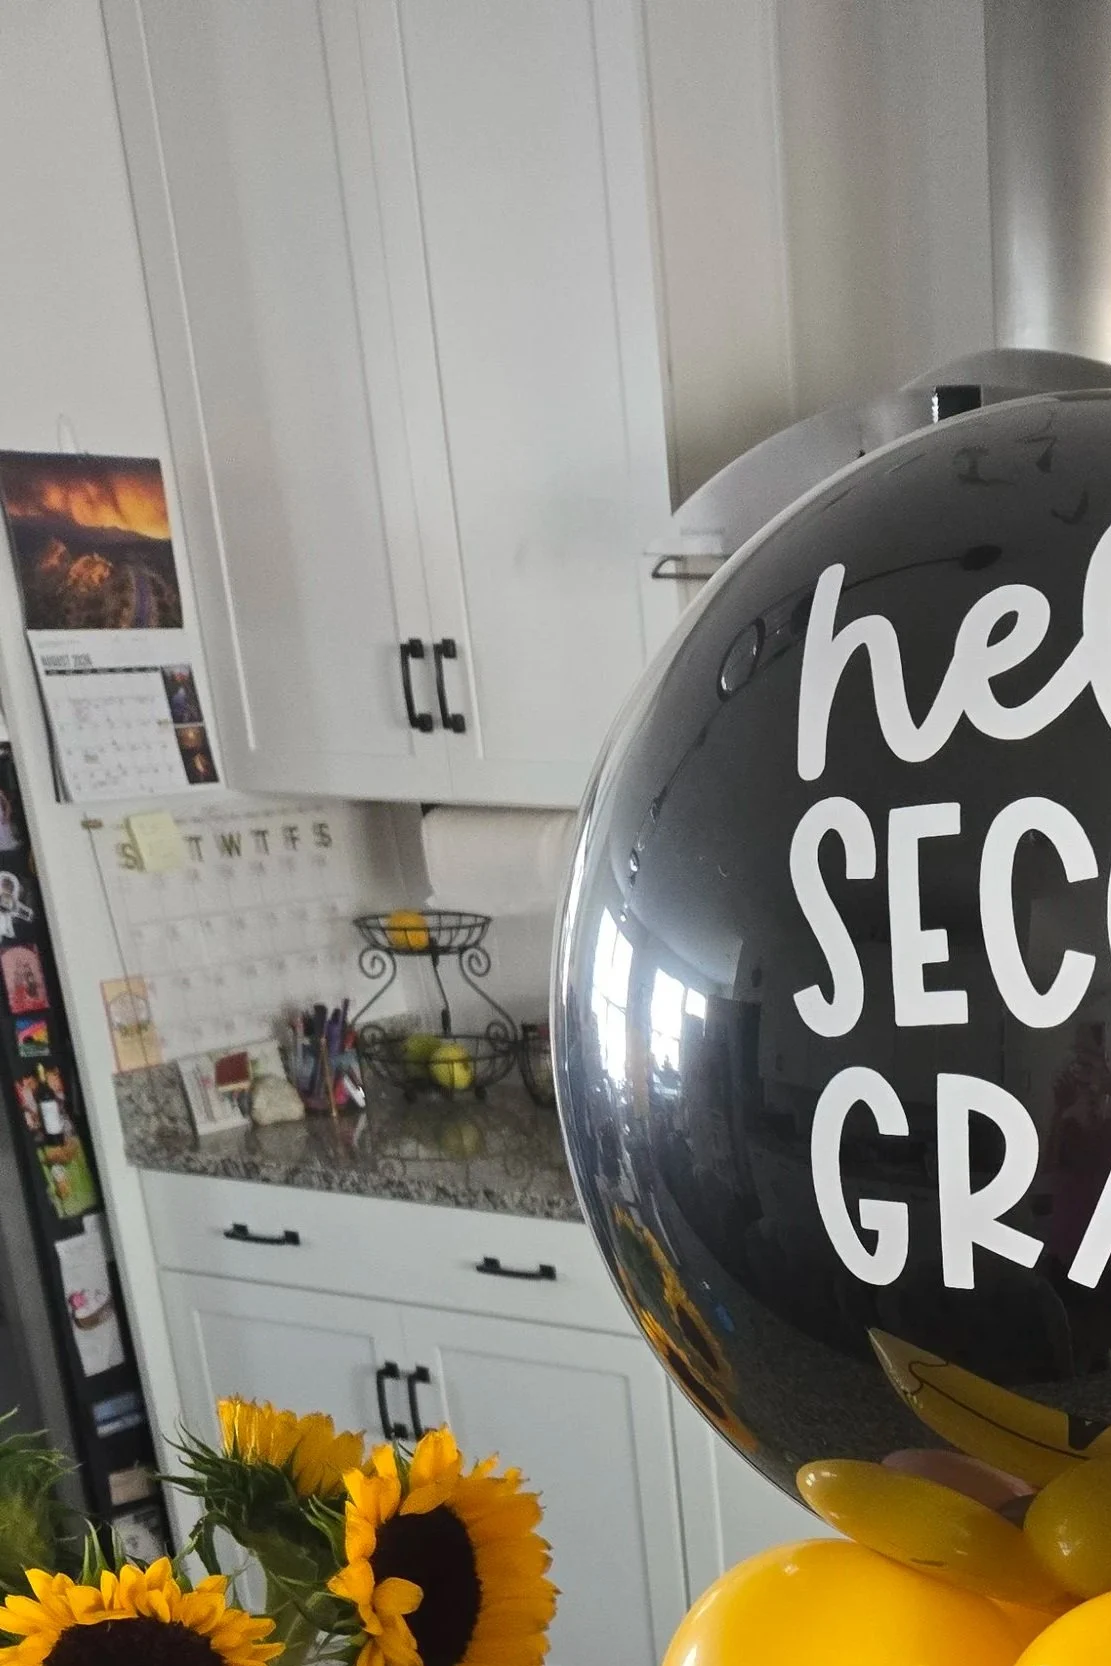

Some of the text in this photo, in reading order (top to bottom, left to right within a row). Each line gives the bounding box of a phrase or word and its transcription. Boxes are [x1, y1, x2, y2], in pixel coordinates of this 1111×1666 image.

[214, 830, 242, 858] W
[251, 828, 270, 856] T
[311, 822, 333, 849] S
